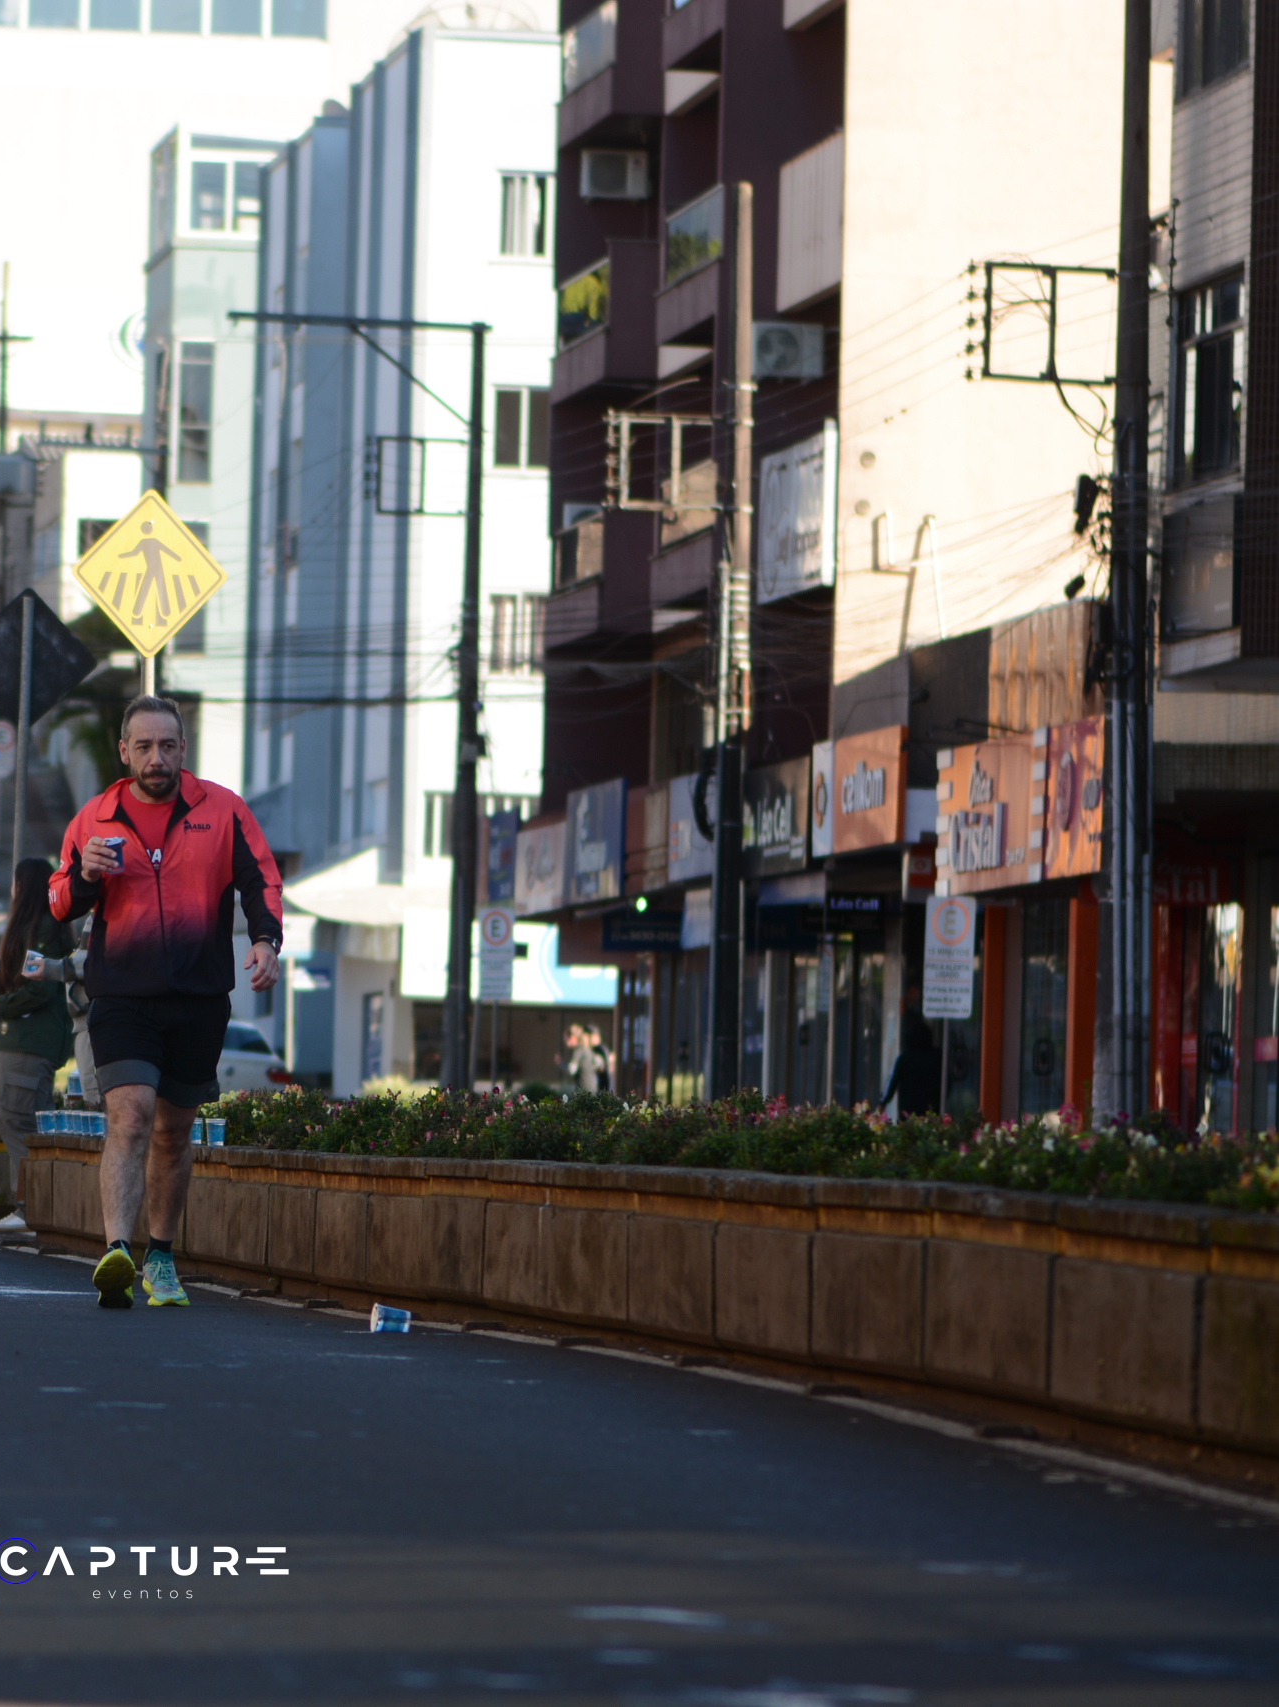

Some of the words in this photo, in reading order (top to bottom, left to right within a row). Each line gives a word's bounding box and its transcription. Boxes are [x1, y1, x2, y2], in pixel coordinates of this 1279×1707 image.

[949, 802, 1003, 873] Cristal
[1153, 866, 1219, 903] stal
[491, 919, 501, 938] E
[944, 909, 957, 935] E
[937, 948, 970, 956] MINUTOS
